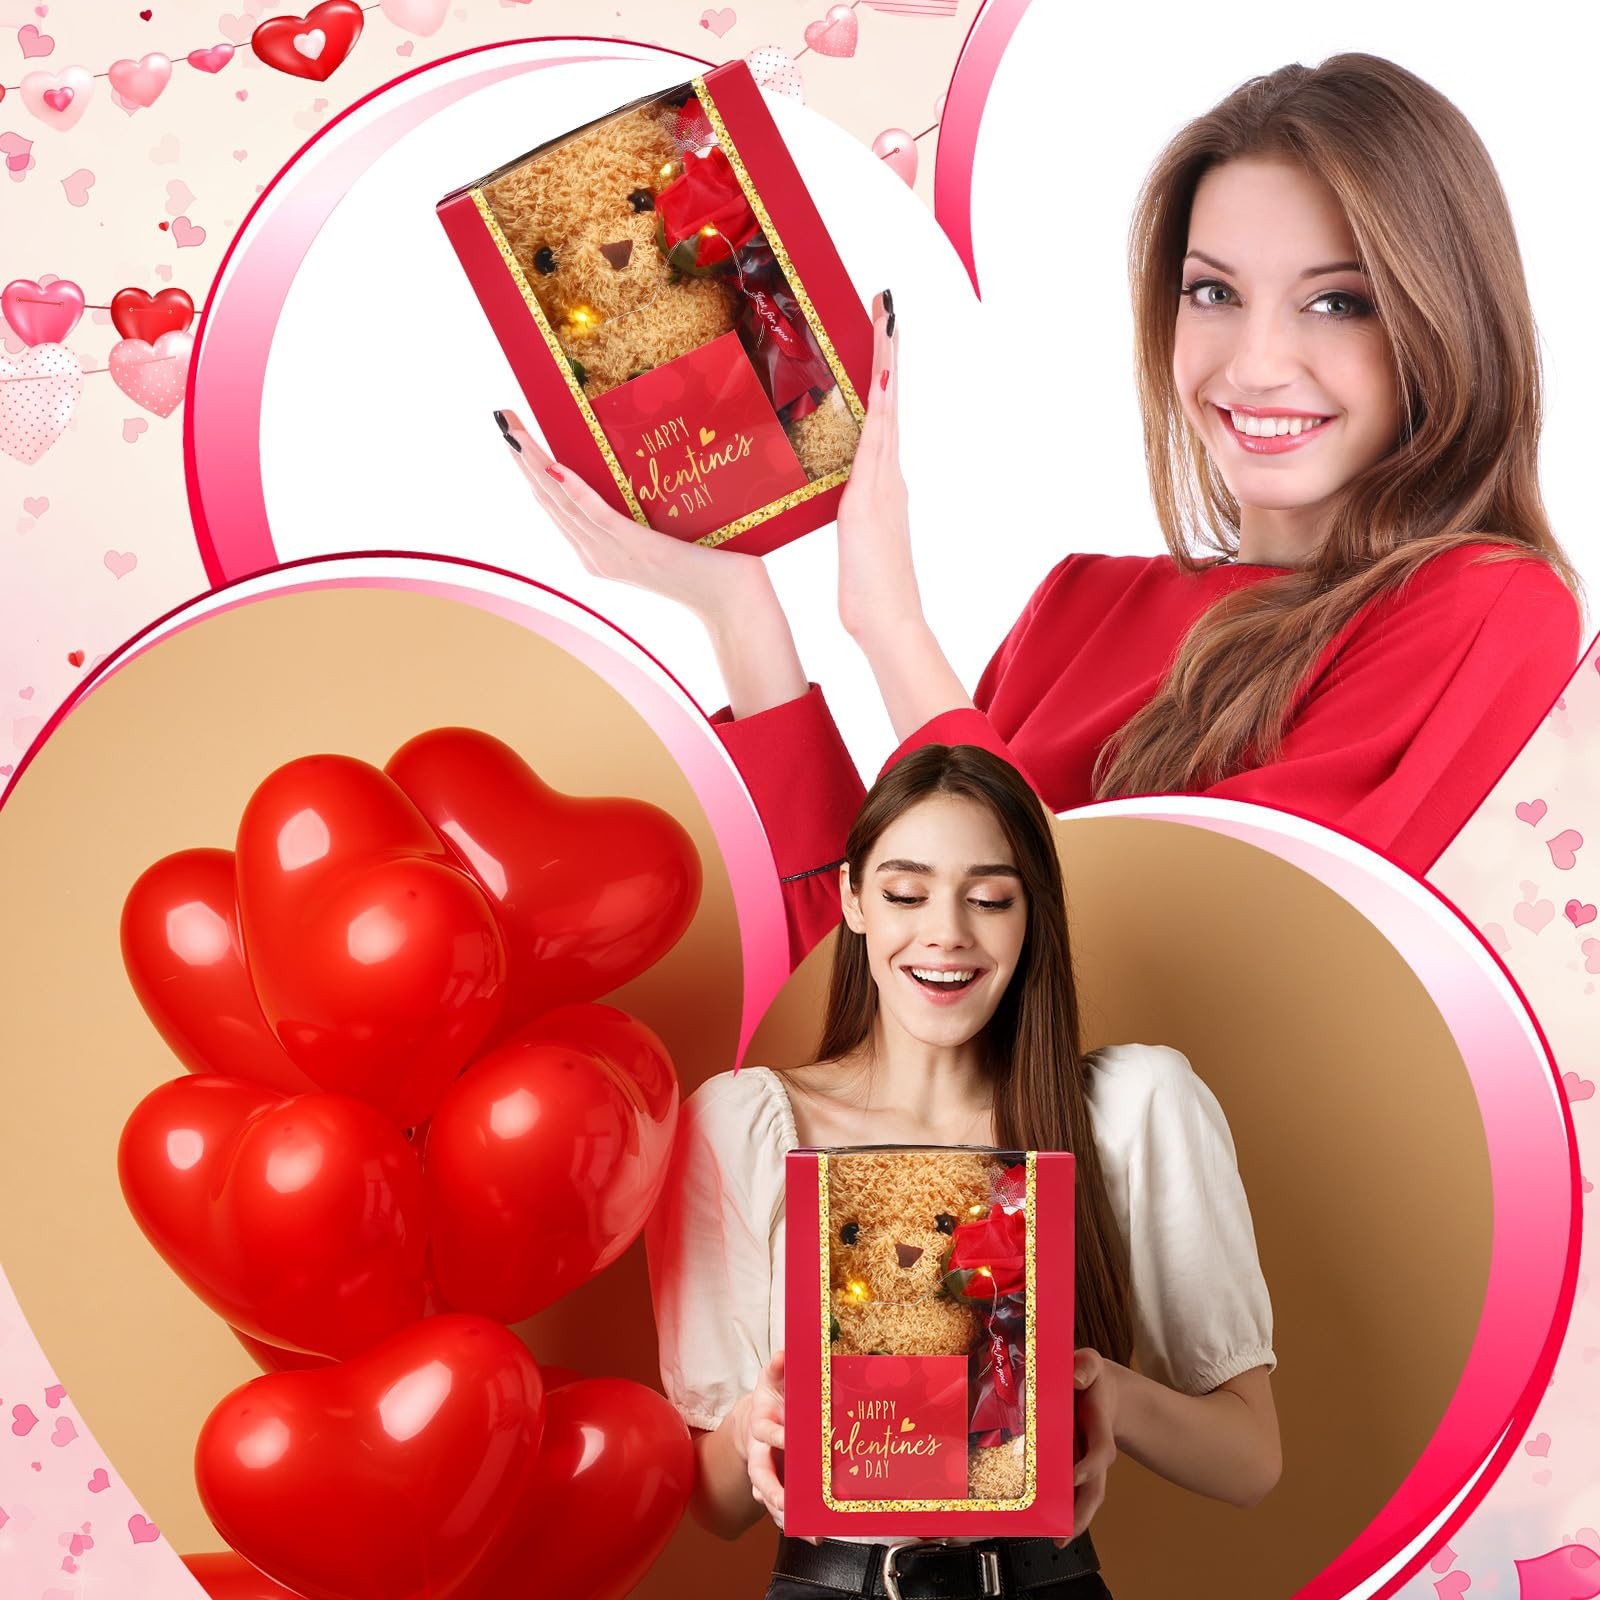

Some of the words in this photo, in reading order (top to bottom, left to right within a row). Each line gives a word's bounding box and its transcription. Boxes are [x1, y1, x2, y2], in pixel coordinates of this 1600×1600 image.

[642, 416, 690, 455] HAPPY
[681, 483, 713, 514] DAY
[858, 1400, 896, 1420] HAPPY
[865, 1460, 889, 1479] DAY
